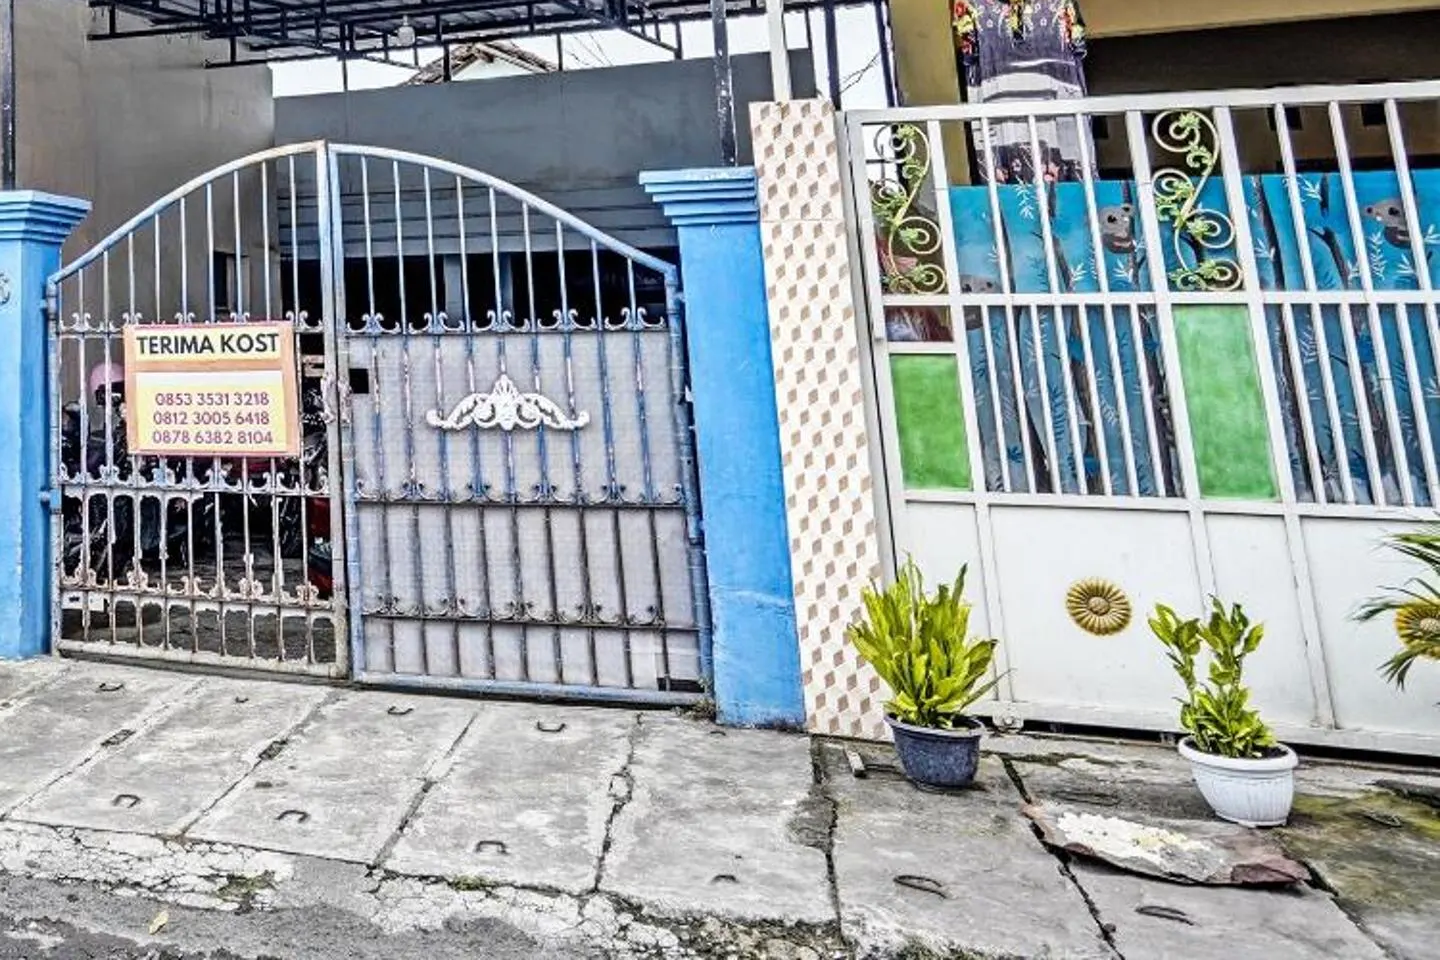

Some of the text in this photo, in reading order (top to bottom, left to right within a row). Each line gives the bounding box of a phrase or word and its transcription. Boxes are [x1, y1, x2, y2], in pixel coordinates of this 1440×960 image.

[136, 333, 279, 354] TERIMA KOST
[155, 391, 270, 406] 0853 3531 3218
[153, 411, 270, 425] 0812 3005 6418
[152, 430, 273, 444] 0878 6382 8104
